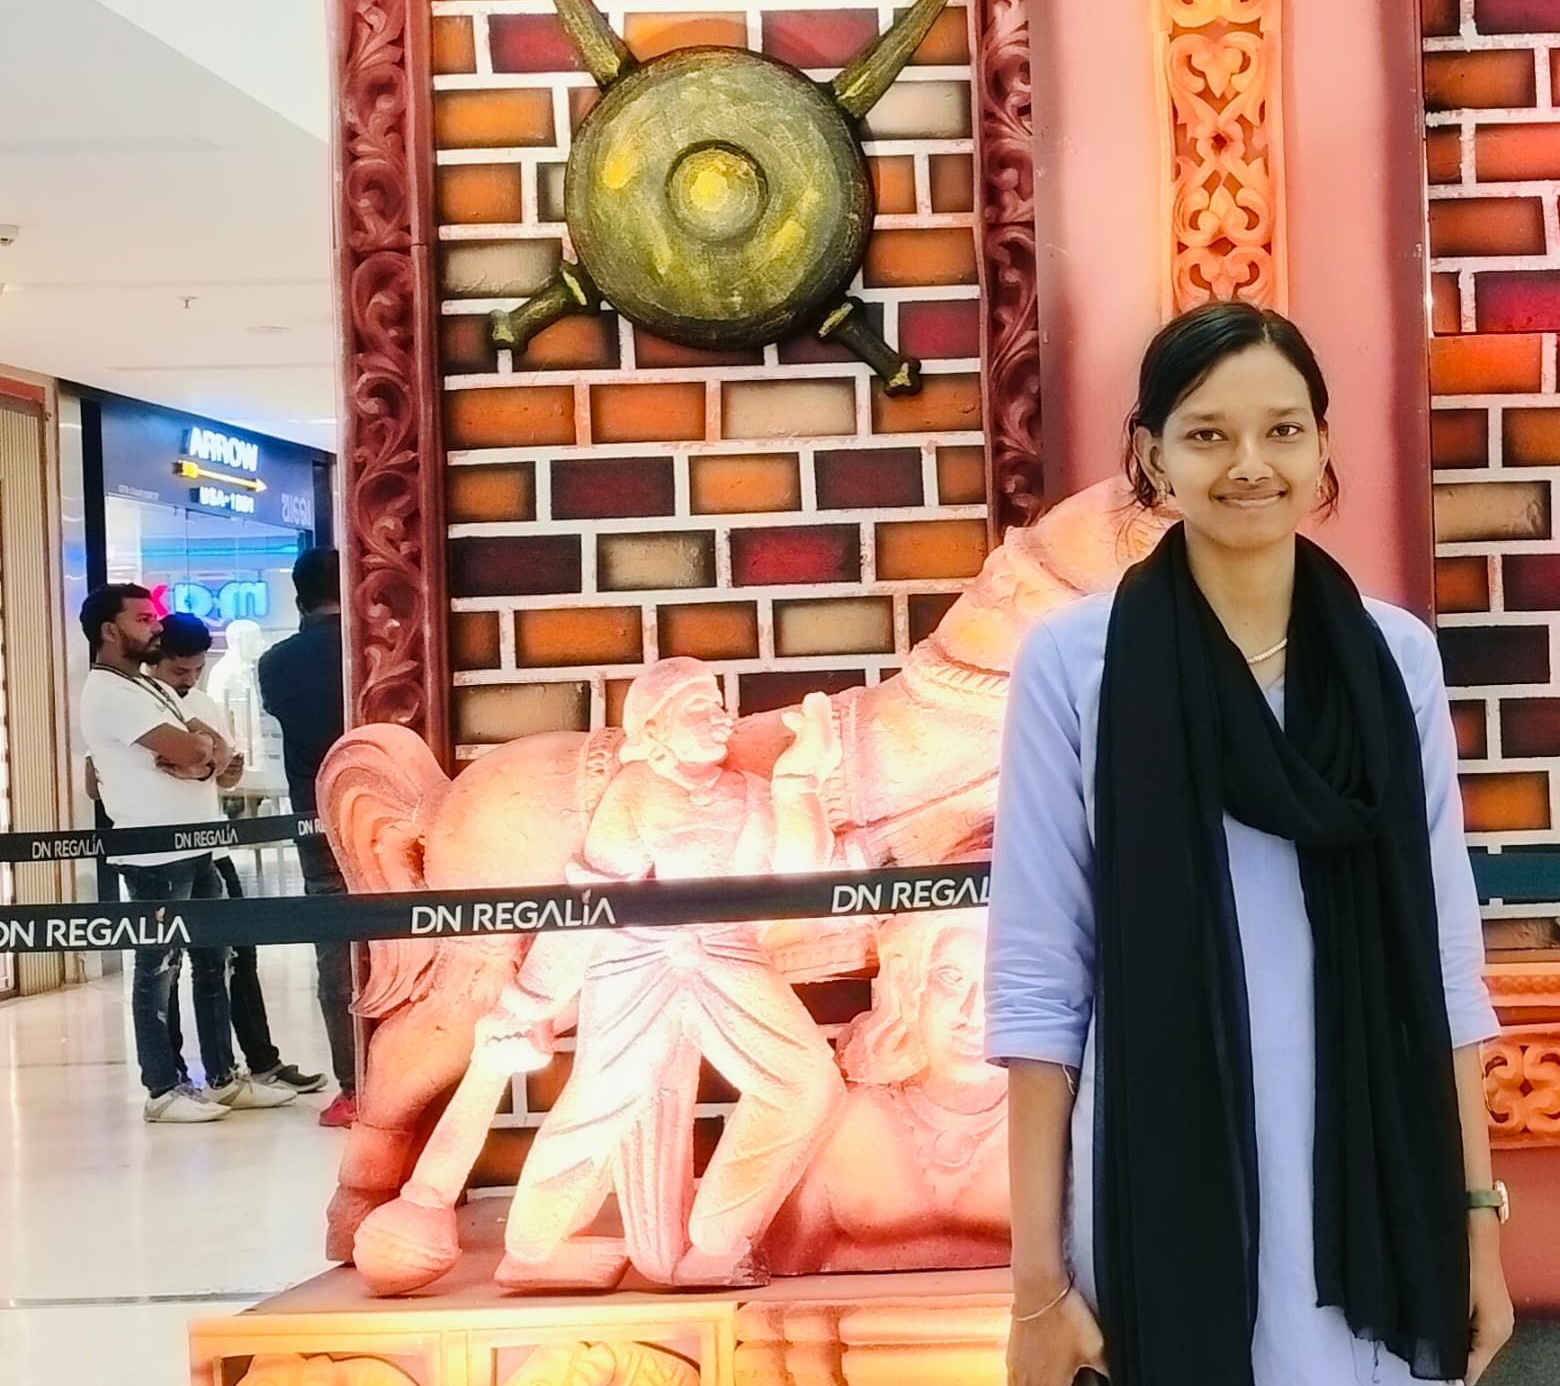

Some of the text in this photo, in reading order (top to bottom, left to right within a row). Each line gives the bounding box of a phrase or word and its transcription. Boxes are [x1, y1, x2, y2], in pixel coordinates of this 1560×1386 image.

[190, 427, 258, 471] ARROW
[297, 819, 313, 836] DN
[32, 841, 51, 859] DN
[174, 832, 192, 849] DN
[831, 875, 991, 914] DN REGAL
[411, 905, 462, 934] DN
